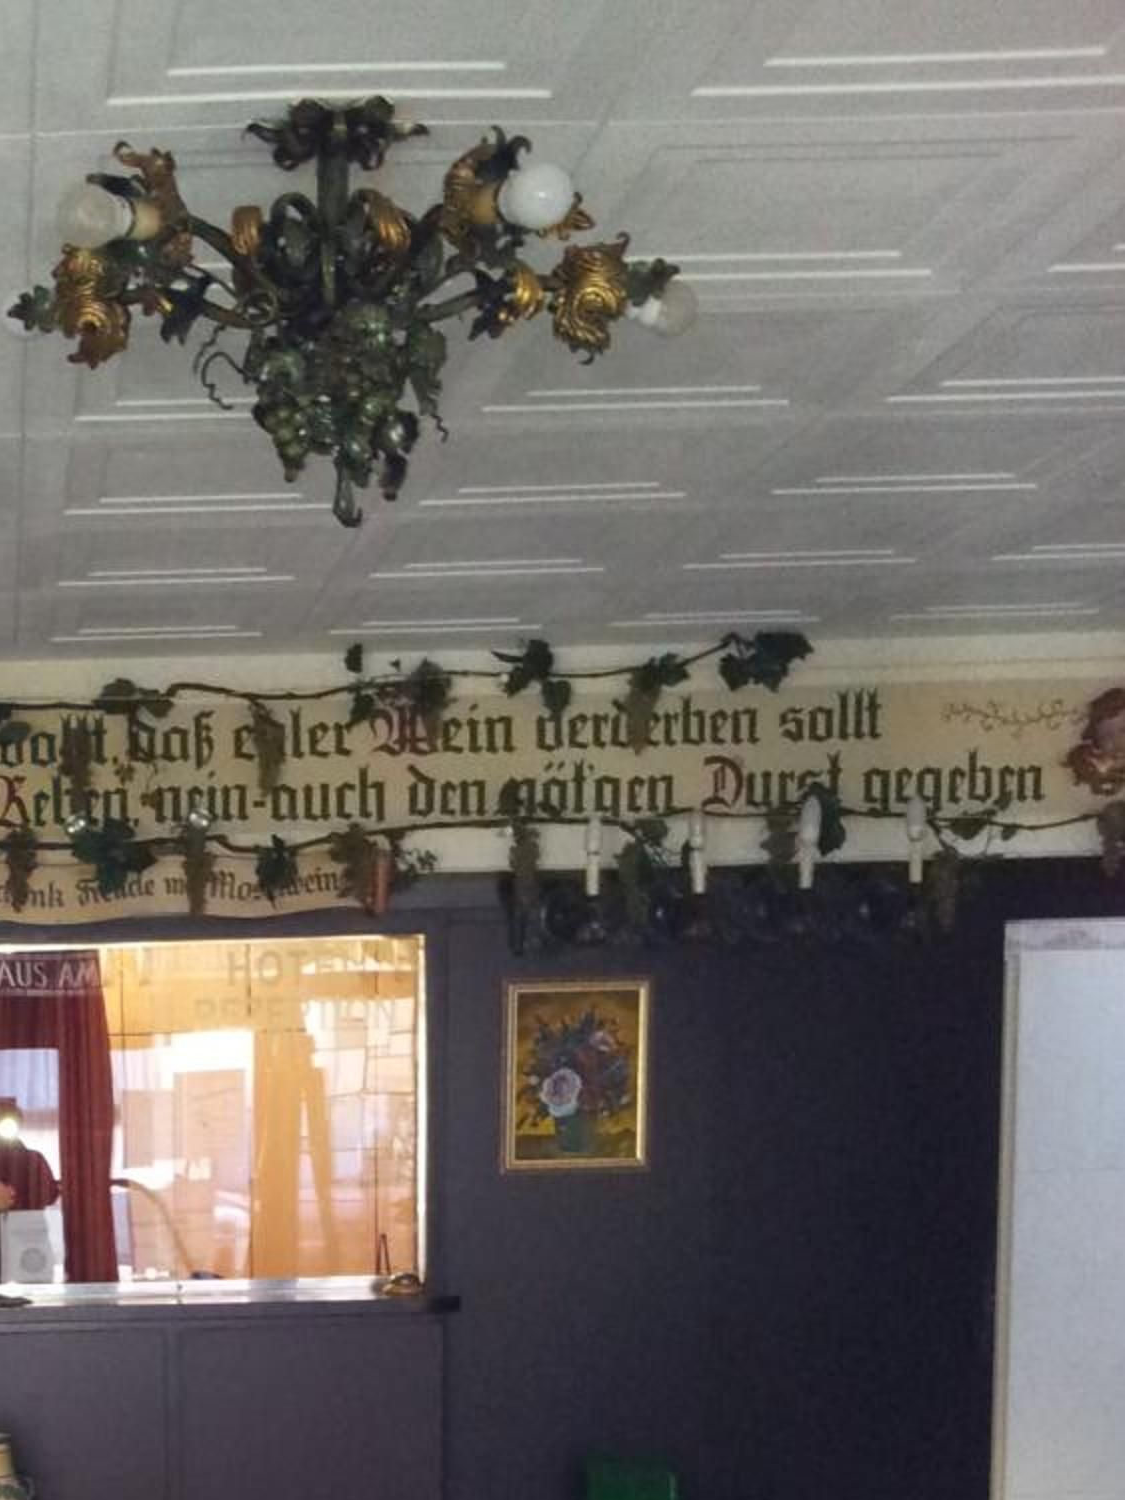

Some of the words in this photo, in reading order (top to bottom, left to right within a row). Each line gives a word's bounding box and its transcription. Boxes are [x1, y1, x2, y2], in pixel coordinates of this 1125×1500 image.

[233, 707, 348, 763] eler
[779, 690, 883, 743] sollt
[407, 763, 486, 818] den
[862, 746, 1046, 811] gegeben
